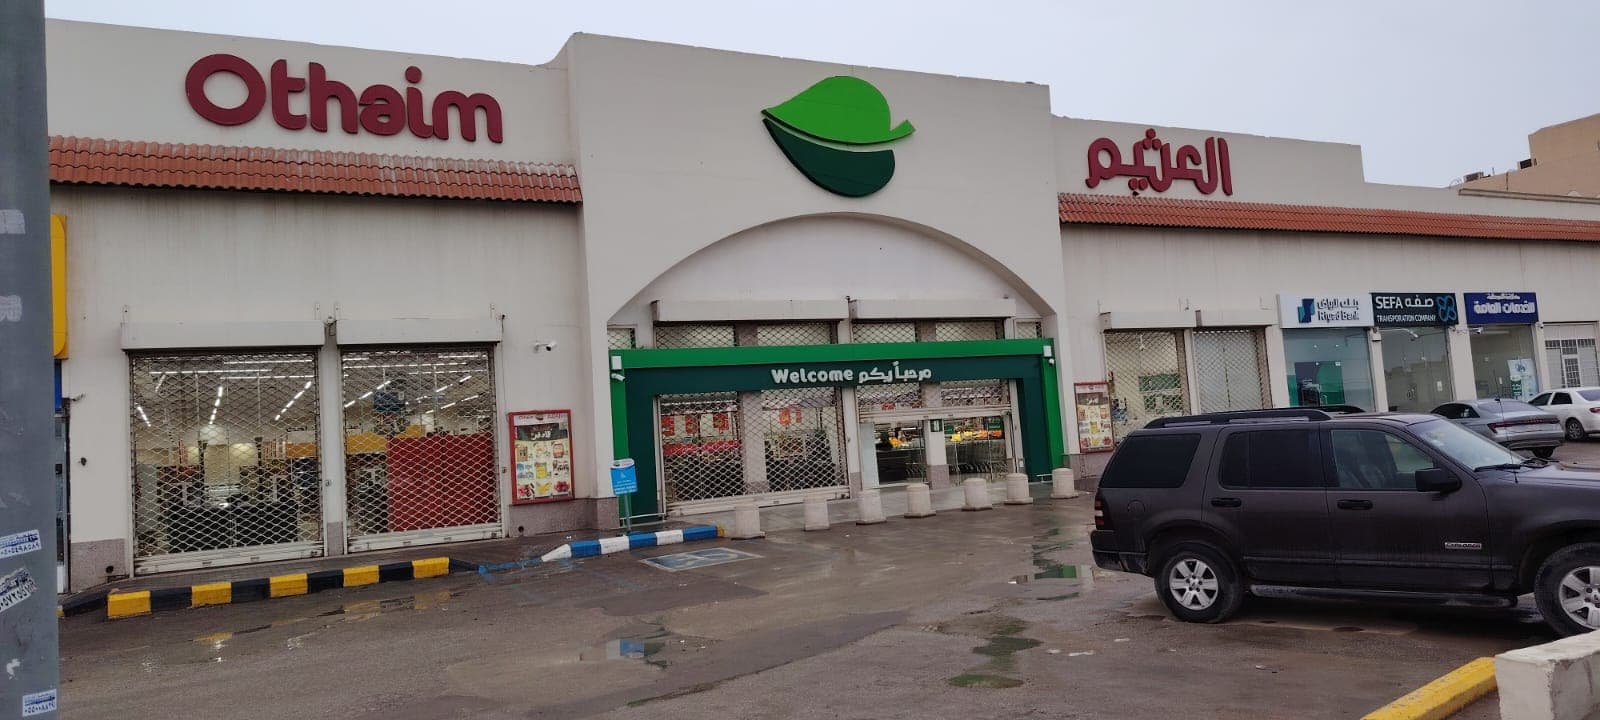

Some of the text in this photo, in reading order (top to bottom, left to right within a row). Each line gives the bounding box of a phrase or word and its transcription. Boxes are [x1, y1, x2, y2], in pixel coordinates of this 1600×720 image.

[185, 53, 503, 144] Othaim
[1085, 128, 1233, 196] العثيم
[1375, 296, 1403, 309] SEFA
[1414, 314, 1436, 322] COMPANY
[771, 368, 854, 384] Welcome
